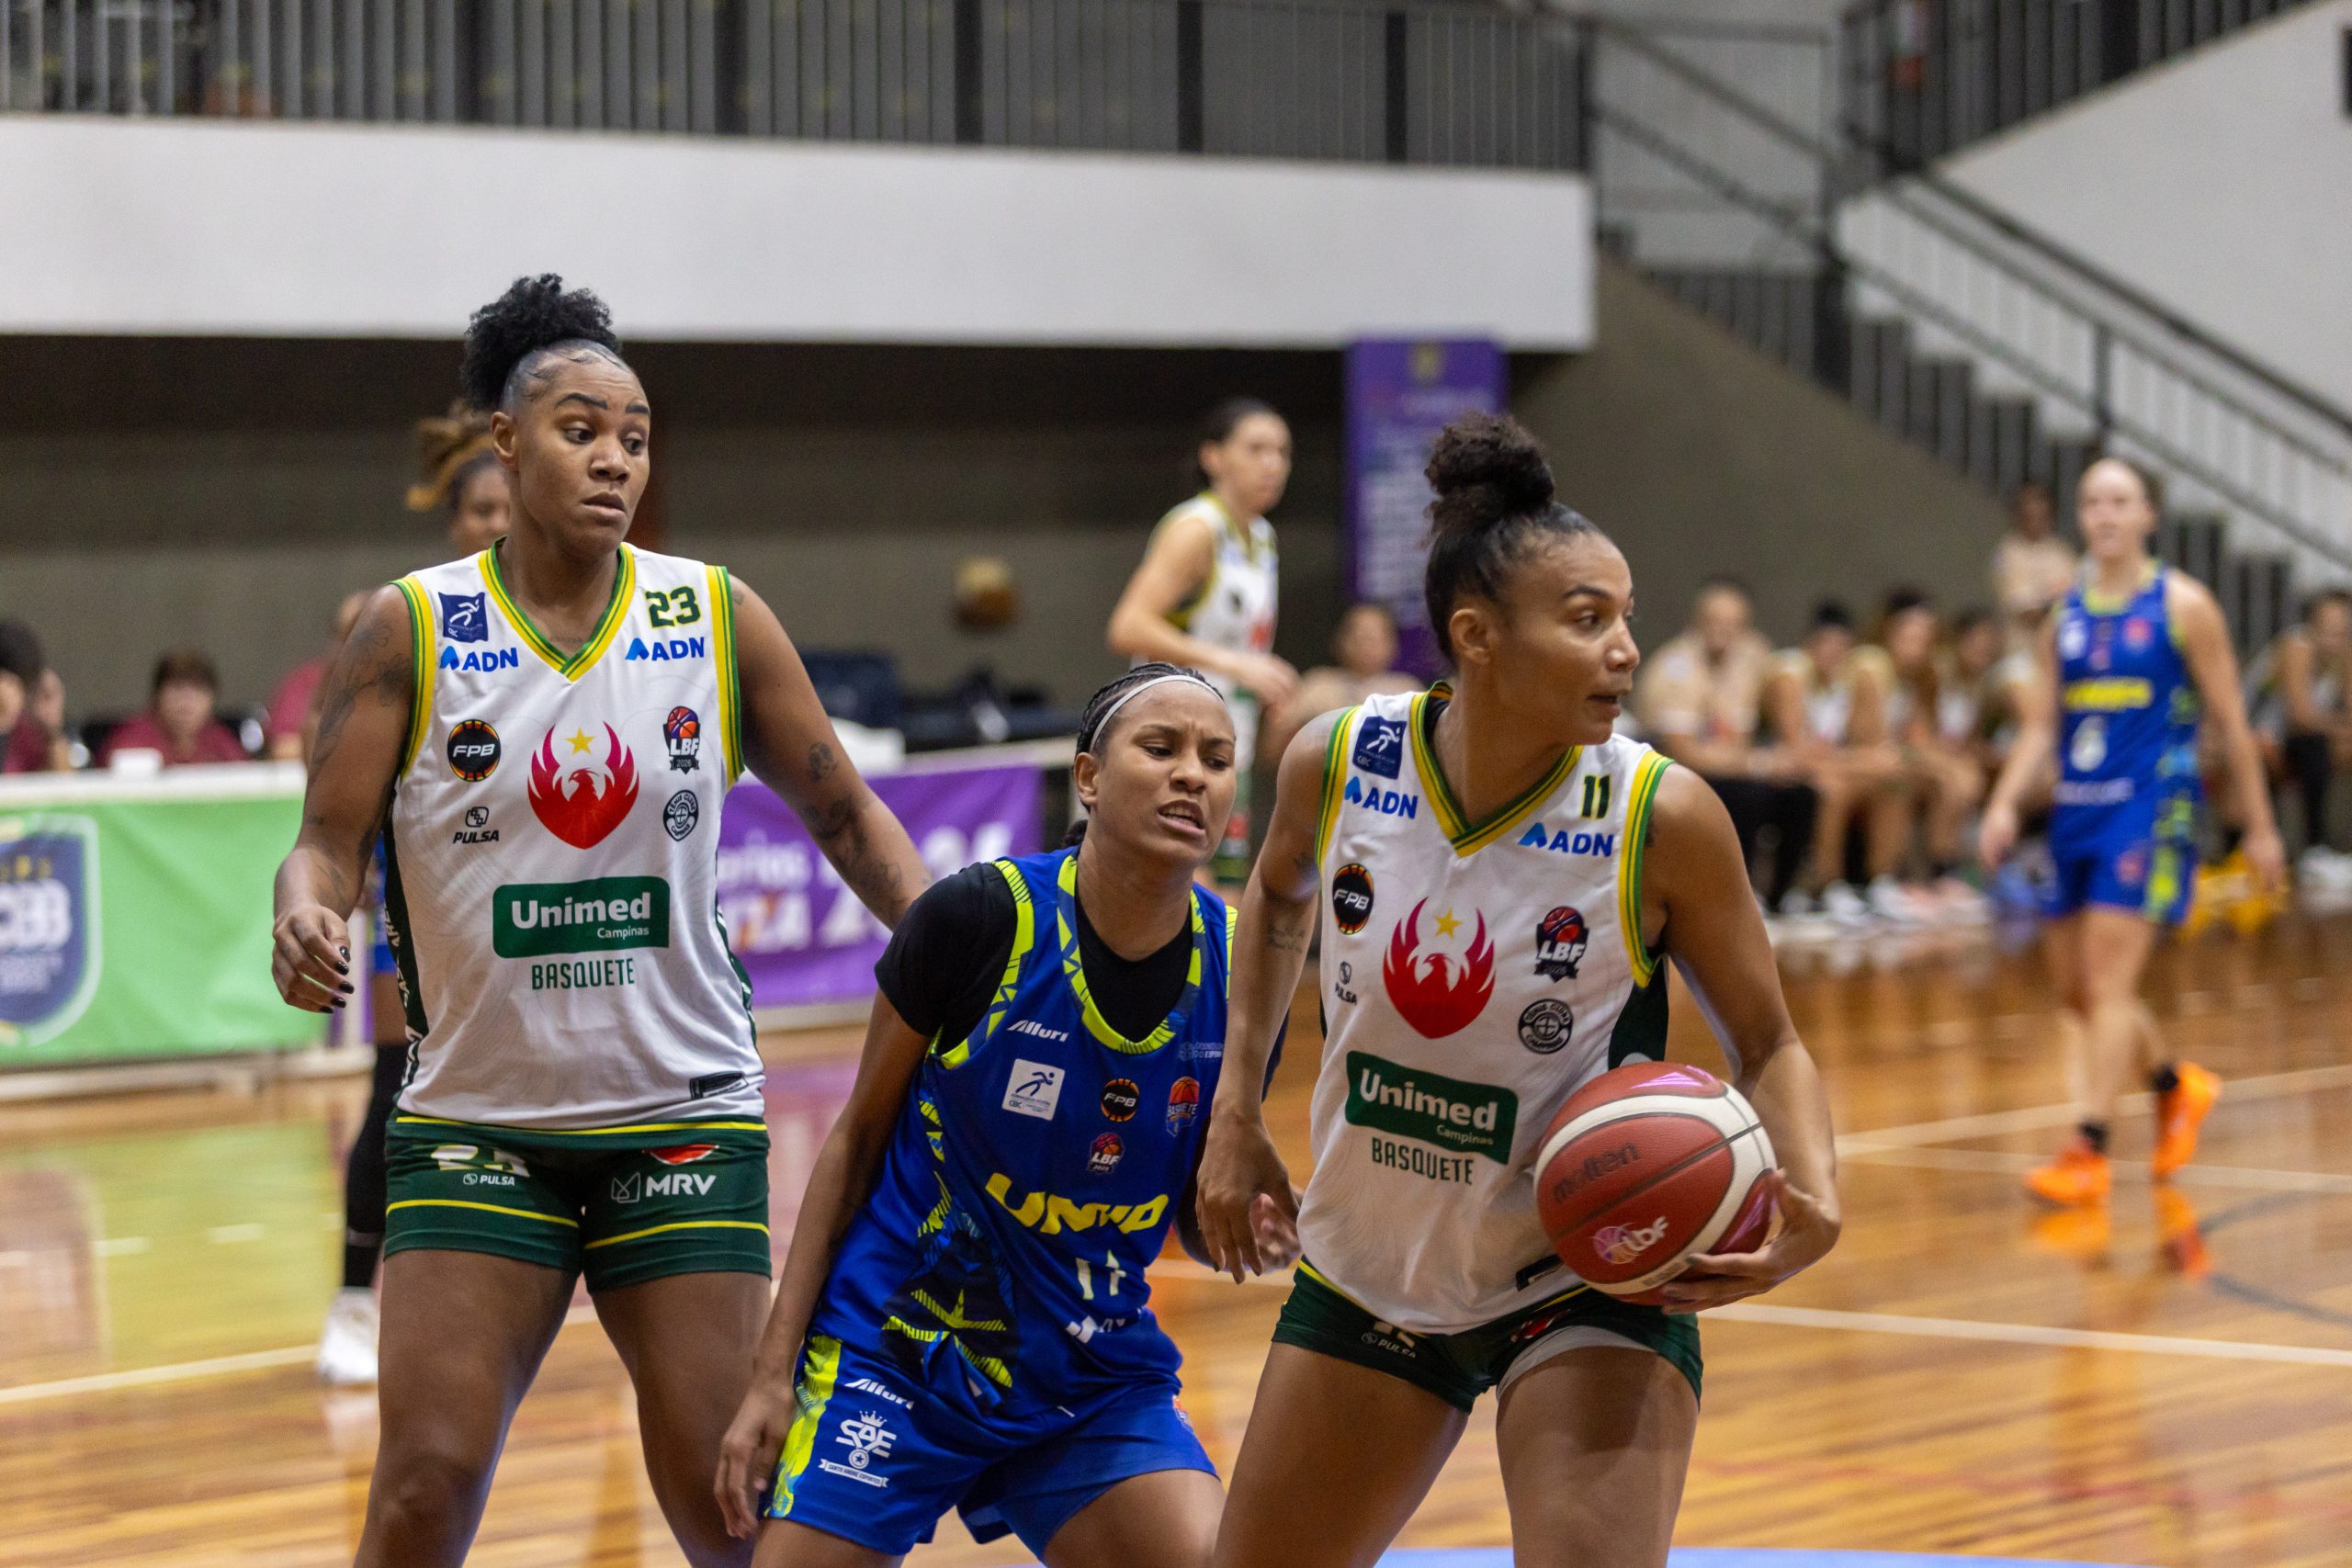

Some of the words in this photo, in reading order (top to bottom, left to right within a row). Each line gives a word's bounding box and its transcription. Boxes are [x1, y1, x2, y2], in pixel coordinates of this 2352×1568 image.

[645, 586, 702, 628] 23
[461, 647, 519, 672] ADN
[651, 636, 705, 661] ADN
[453, 743, 495, 758] FPB
[670, 738, 700, 756] LBF
[1363, 786, 1418, 820] ADN
[1580, 774, 1611, 820] 11
[453, 829, 500, 844] PULSA
[1548, 829, 1614, 858] ADN
[511, 891, 652, 931] Unimed
[1334, 888, 1371, 910] FPB
[596, 924, 650, 941] Campinas
[1538, 940, 1586, 964] LBF
[531, 957, 636, 990] BASQUETE
[1103, 1092, 1137, 1108] FPB
[1360, 1067, 1498, 1132] Unimed
[1436, 1123, 1495, 1145] Campinas
[1091, 1152, 1120, 1166] LBF
[1372, 1137, 1475, 1185] BASQUETE
[480, 1175, 515, 1186] PULSA
[646, 1173, 717, 1197] MRV
